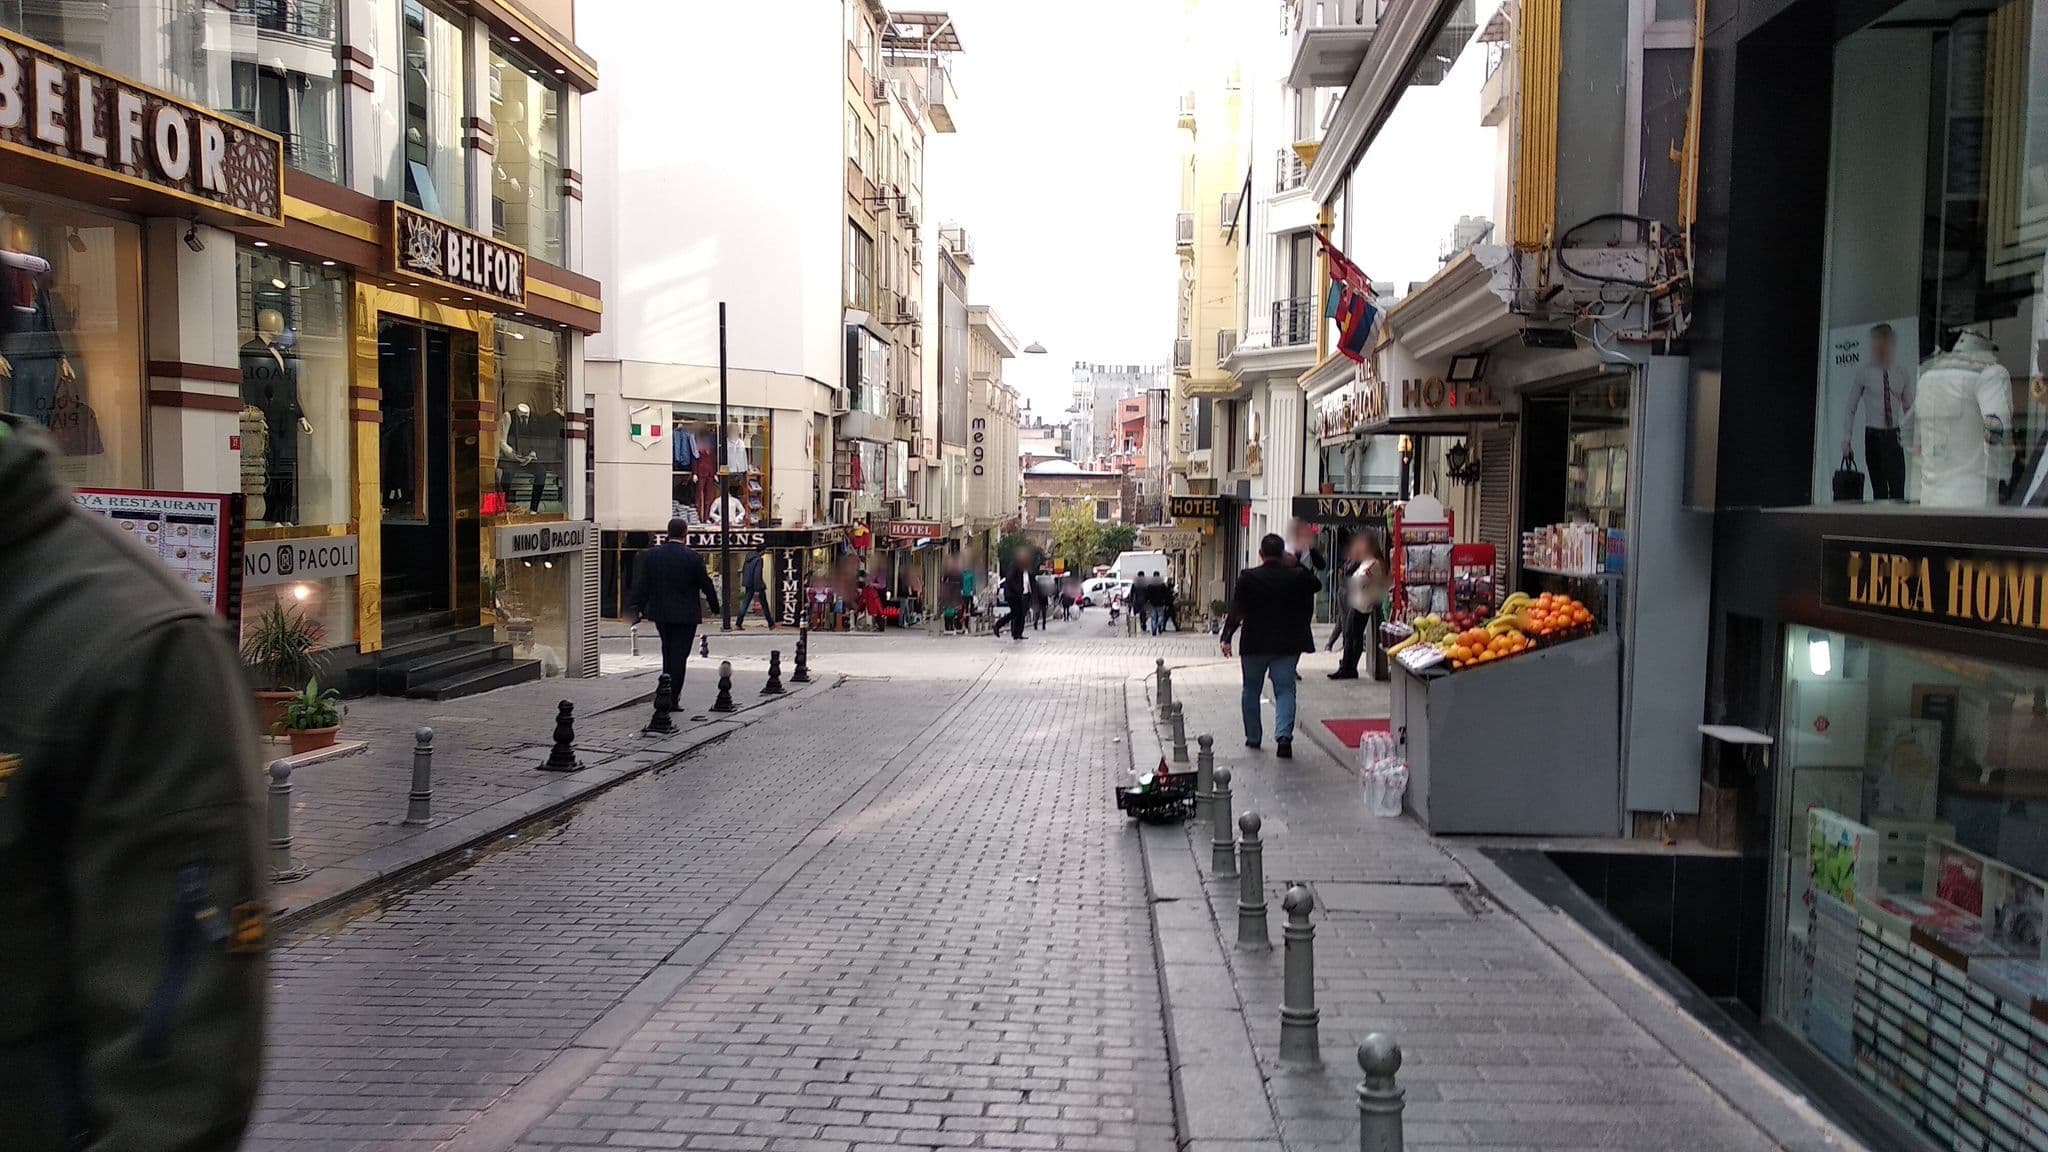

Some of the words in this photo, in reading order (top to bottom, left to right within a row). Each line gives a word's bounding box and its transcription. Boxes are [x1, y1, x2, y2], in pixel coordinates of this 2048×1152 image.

[0, 46, 228, 195] BELFOR
[447, 230, 520, 297] BELFOR
[1402, 376, 1500, 409] HOTEL
[972, 417, 986, 476] mega
[109, 496, 218, 512] RESTAURANT
[1173, 499, 1220, 516] HOTEL
[514, 533, 538, 552] NINO
[551, 528, 585, 548] PACOLI
[655, 532, 766, 546] FTMNS
[892, 524, 932, 536] HOTEL
[244, 552, 272, 577] NO
[298, 545, 355, 571] PACOLI
[782, 550, 799, 626] FITMENS
[1849, 550, 1934, 614] LERA
